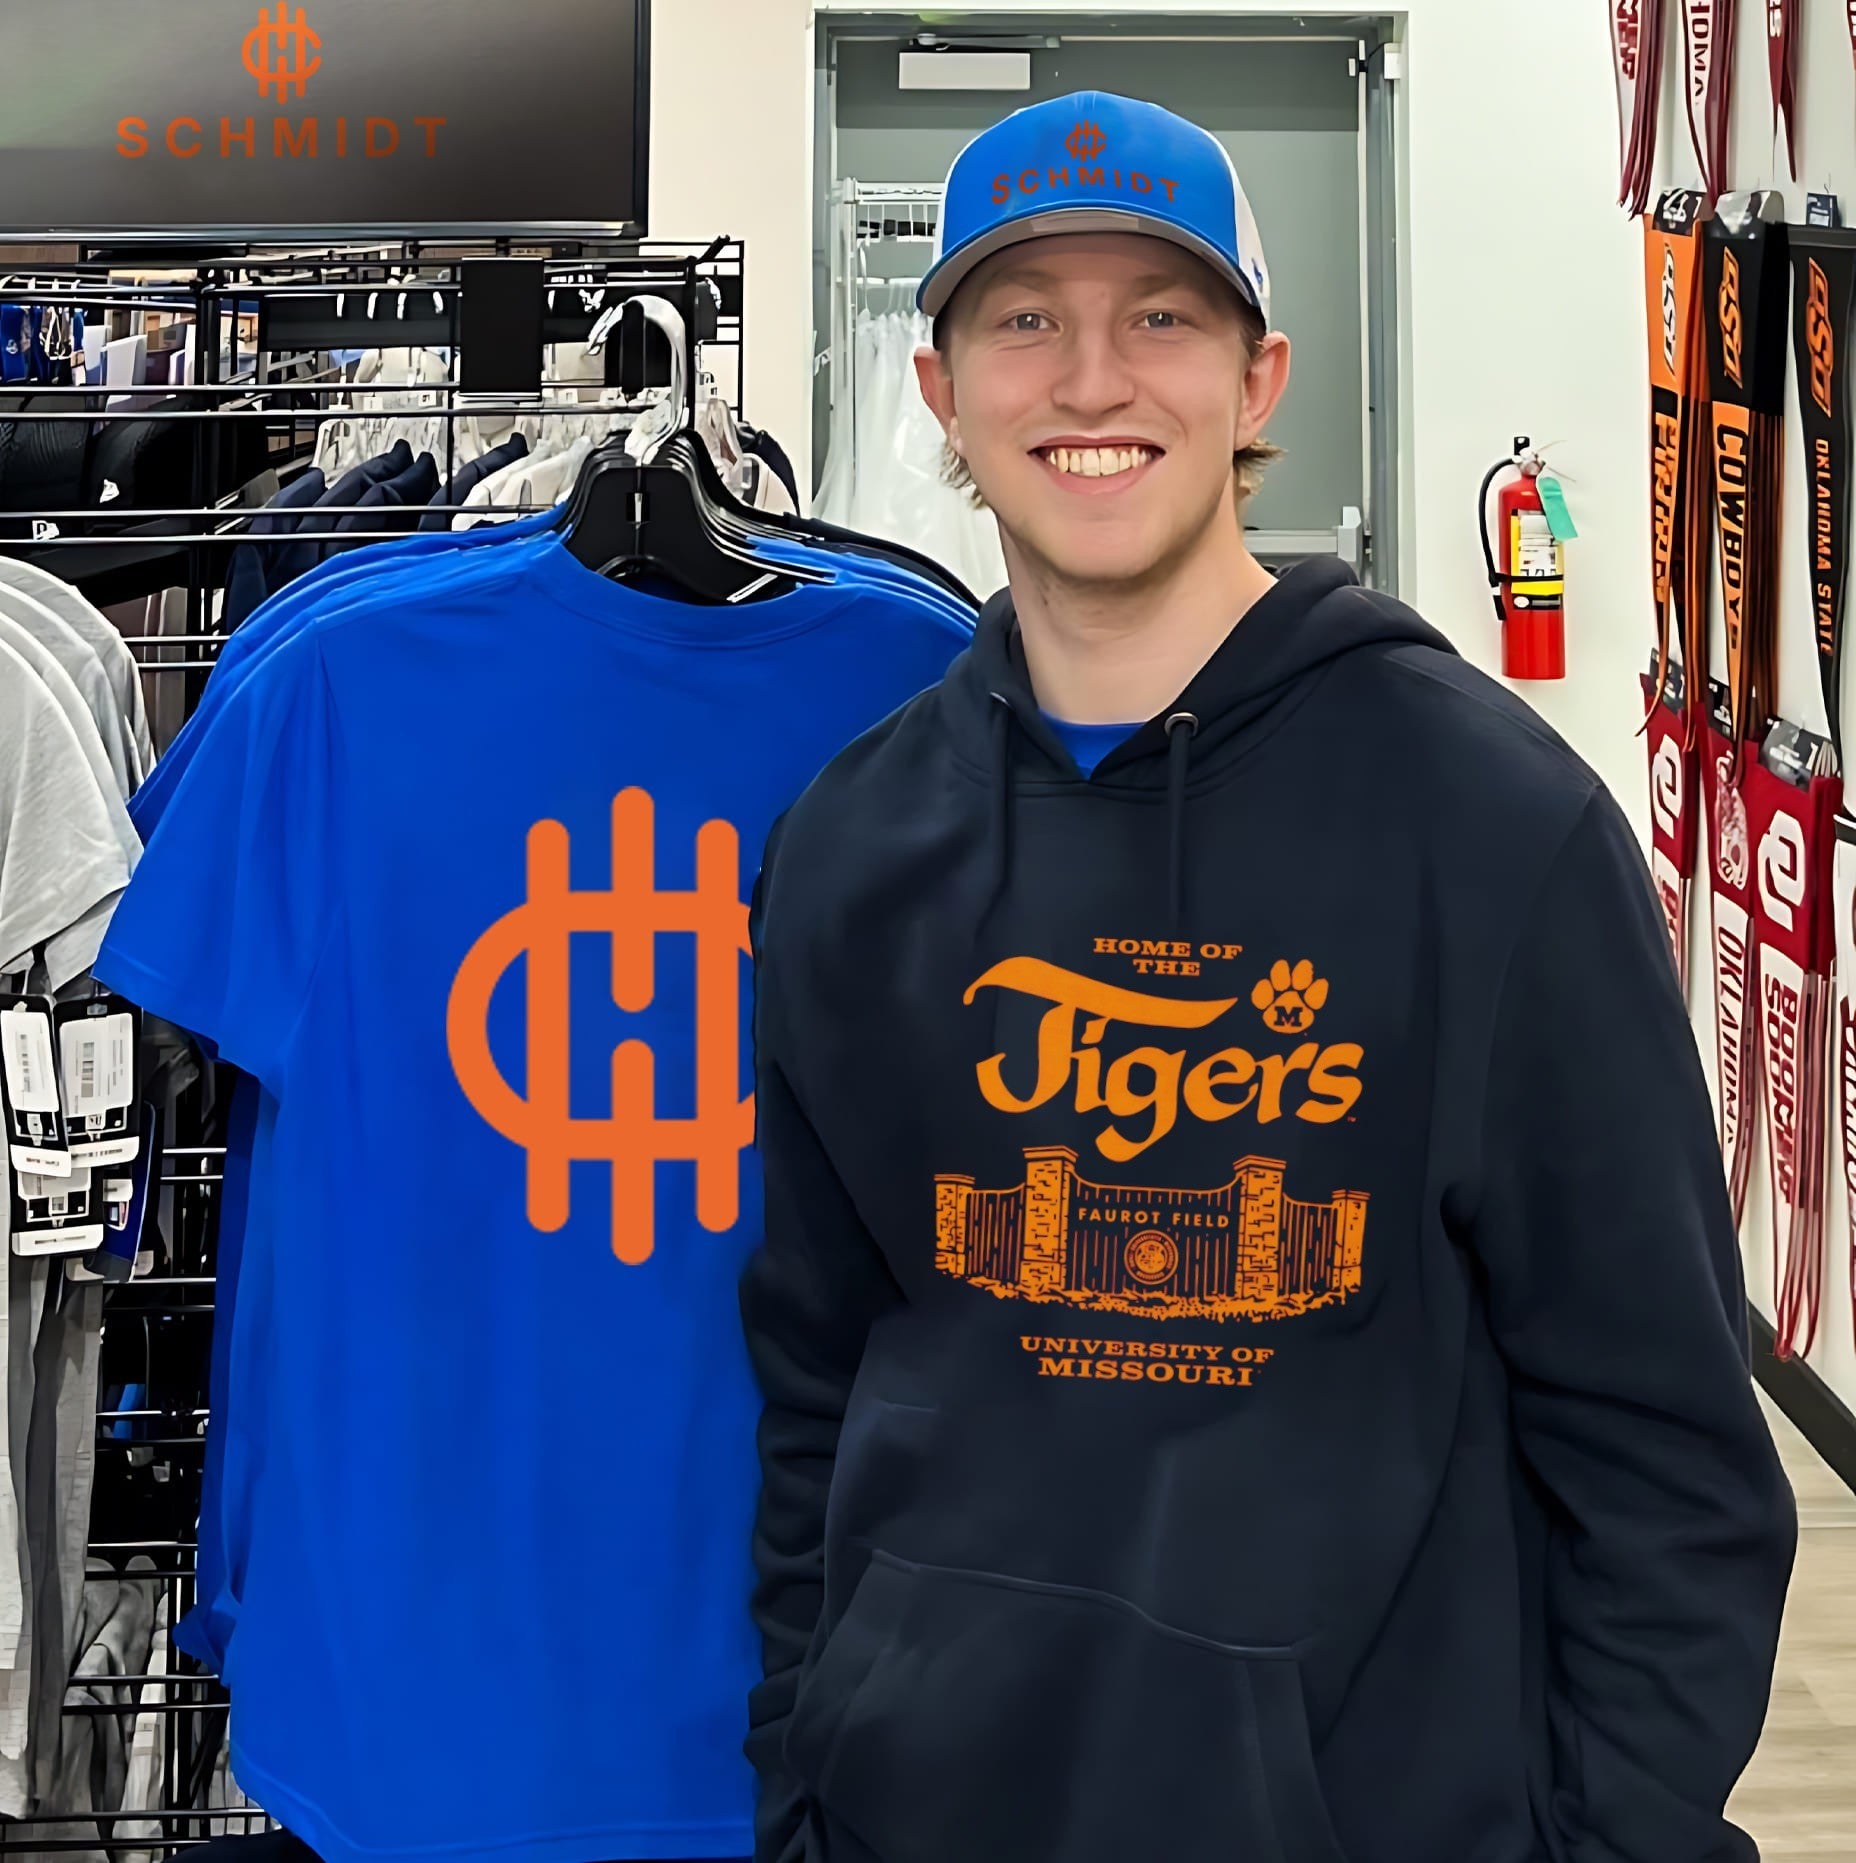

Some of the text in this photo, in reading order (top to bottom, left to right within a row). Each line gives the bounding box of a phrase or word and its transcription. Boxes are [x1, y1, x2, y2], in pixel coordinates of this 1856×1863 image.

[115, 116, 447, 159] SCHMIDT
[992, 167, 1180, 205] SCHMIDT
[1815, 438, 1832, 570] OKLAHOMA
[1094, 938, 1243, 960] HOME OF
[1133, 959, 1201, 977] THE
[1274, 1006, 1304, 1027] M
[1718, 926, 1745, 1143] OKLAHOMA
[963, 956, 1365, 1162] Tigers
[1078, 1207, 1230, 1228] FAUROT FIELD
[1020, 1336, 1275, 1363] UNIVERSITY OF
[1038, 1357, 1253, 1386] MISSOURI
